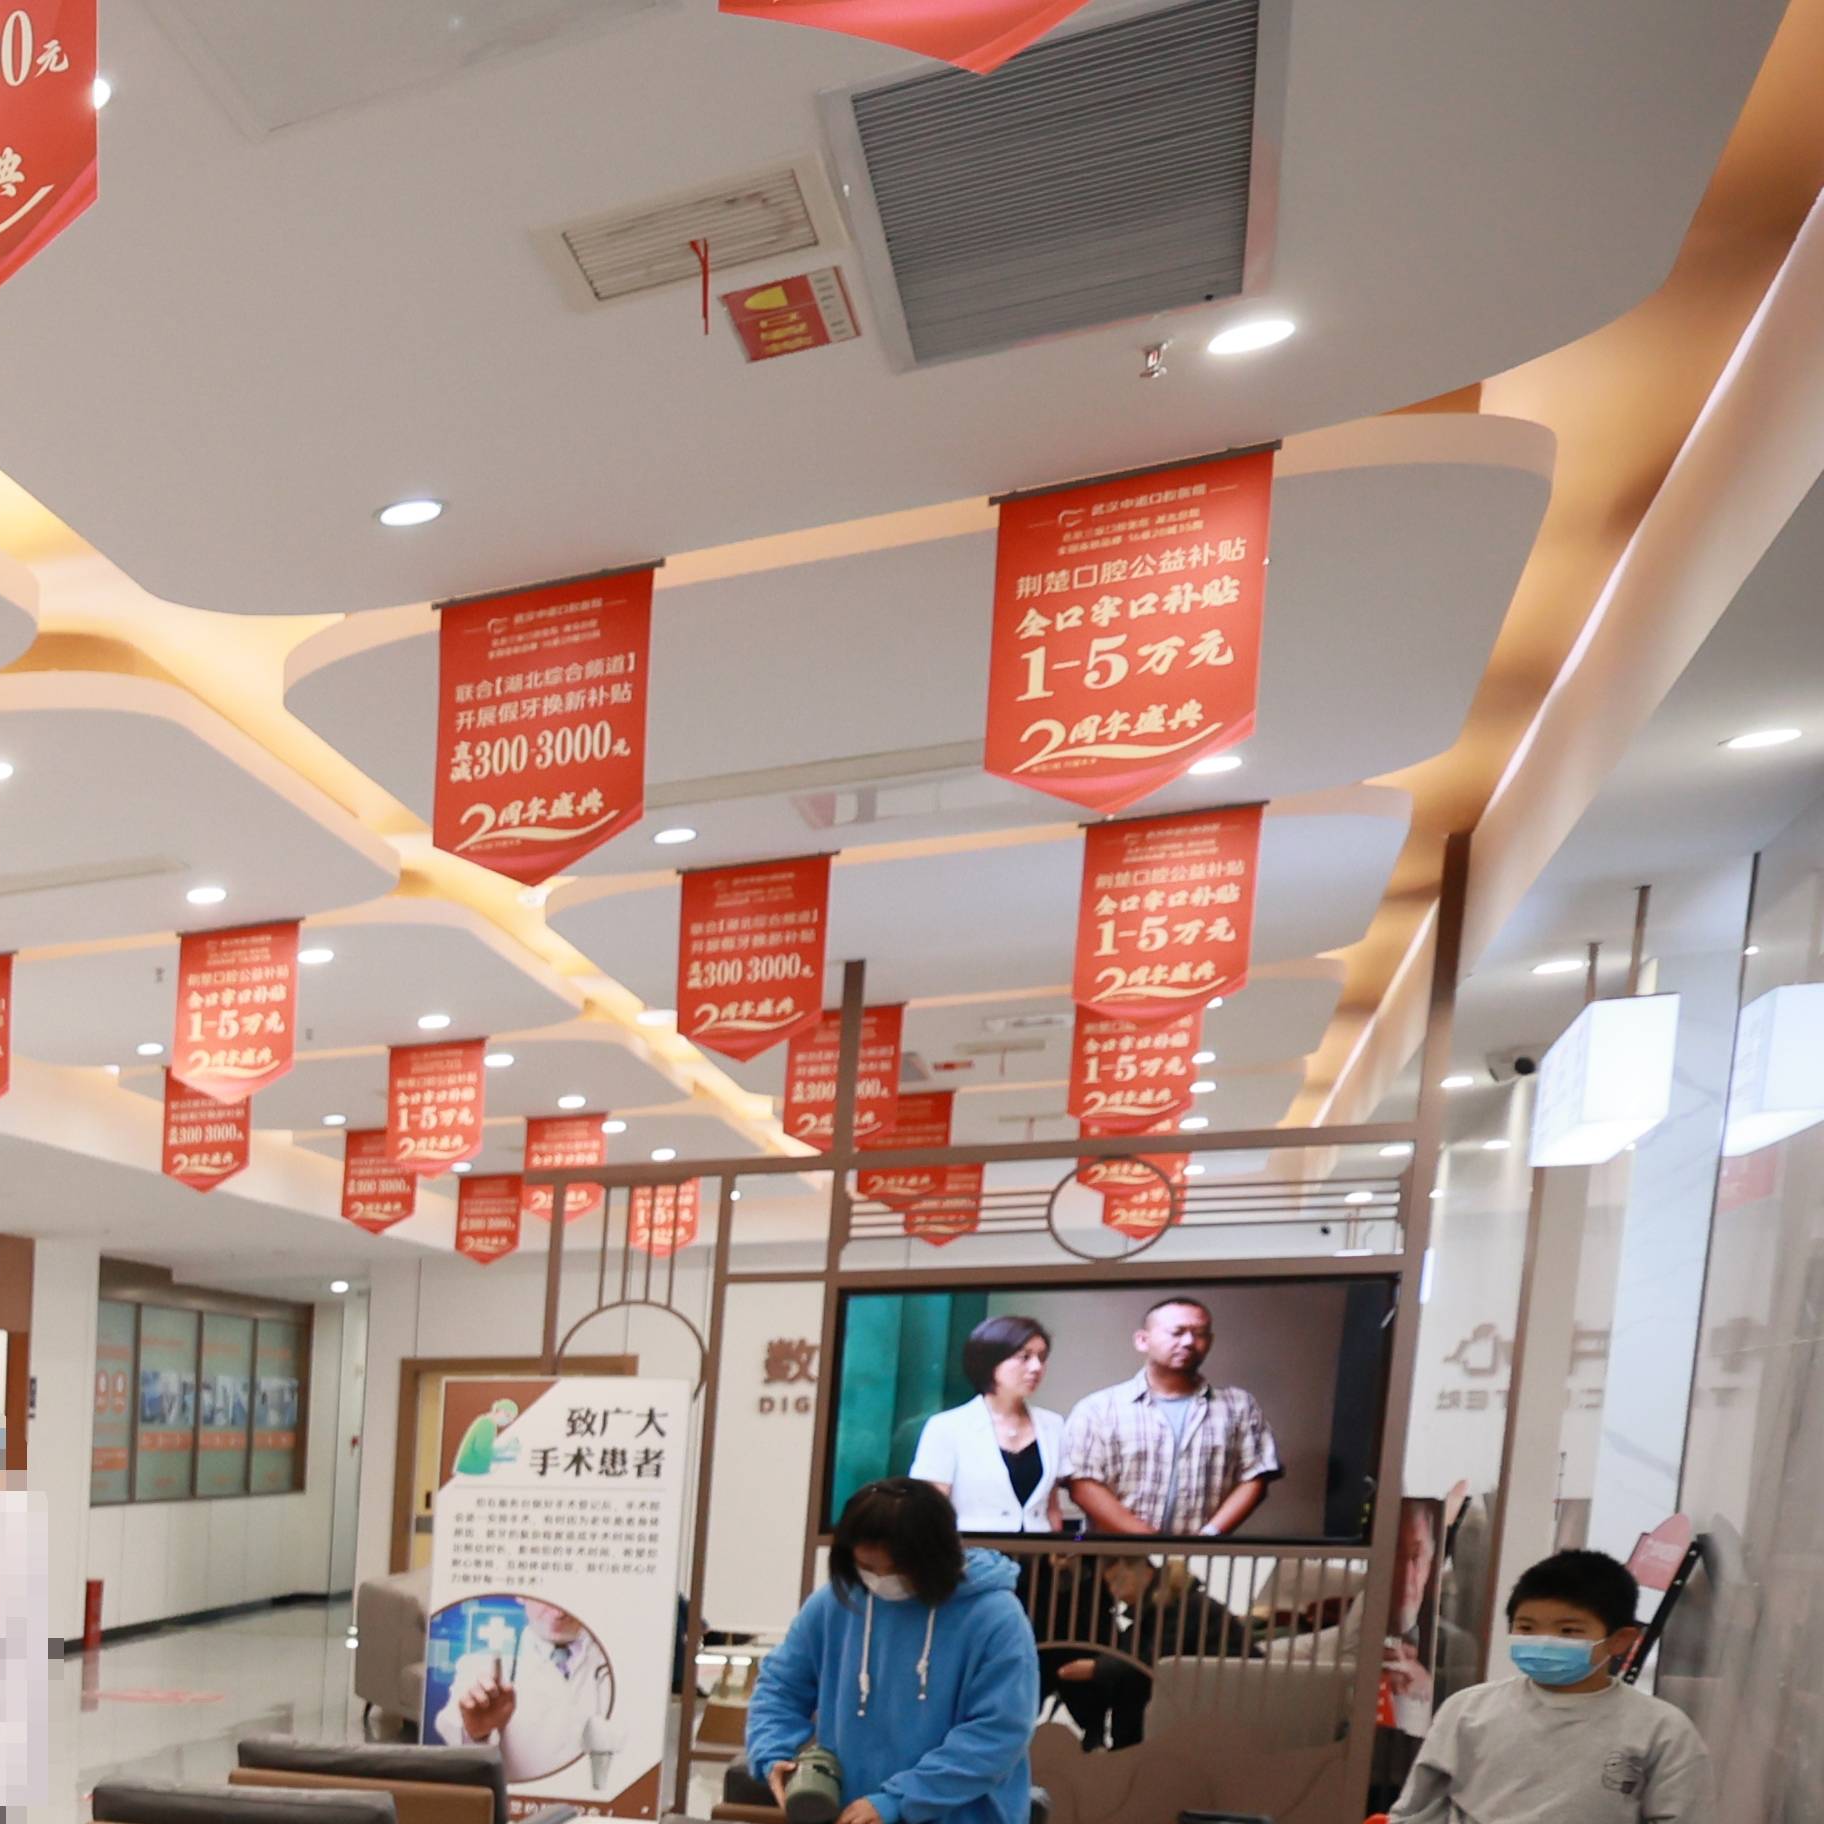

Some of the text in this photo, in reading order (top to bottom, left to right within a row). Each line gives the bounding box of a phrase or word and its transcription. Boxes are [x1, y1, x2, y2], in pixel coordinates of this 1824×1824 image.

[1016, 536, 1247, 600] 荆楚口腔公益补贴
[1014, 628, 1235, 701] 1-5万元
[455, 680, 632, 734] 开展假牙换新补贴
[1010, 698, 1220, 774] 2周年盛典
[1093, 915, 1236, 958] 1-5万元
[187, 1009, 285, 1043] 1-5万元
[1083, 1054, 1187, 1084] 1-5万元
[565, 1407, 669, 1439] 致广大
[529, 1446, 666, 1479] 手术患者
